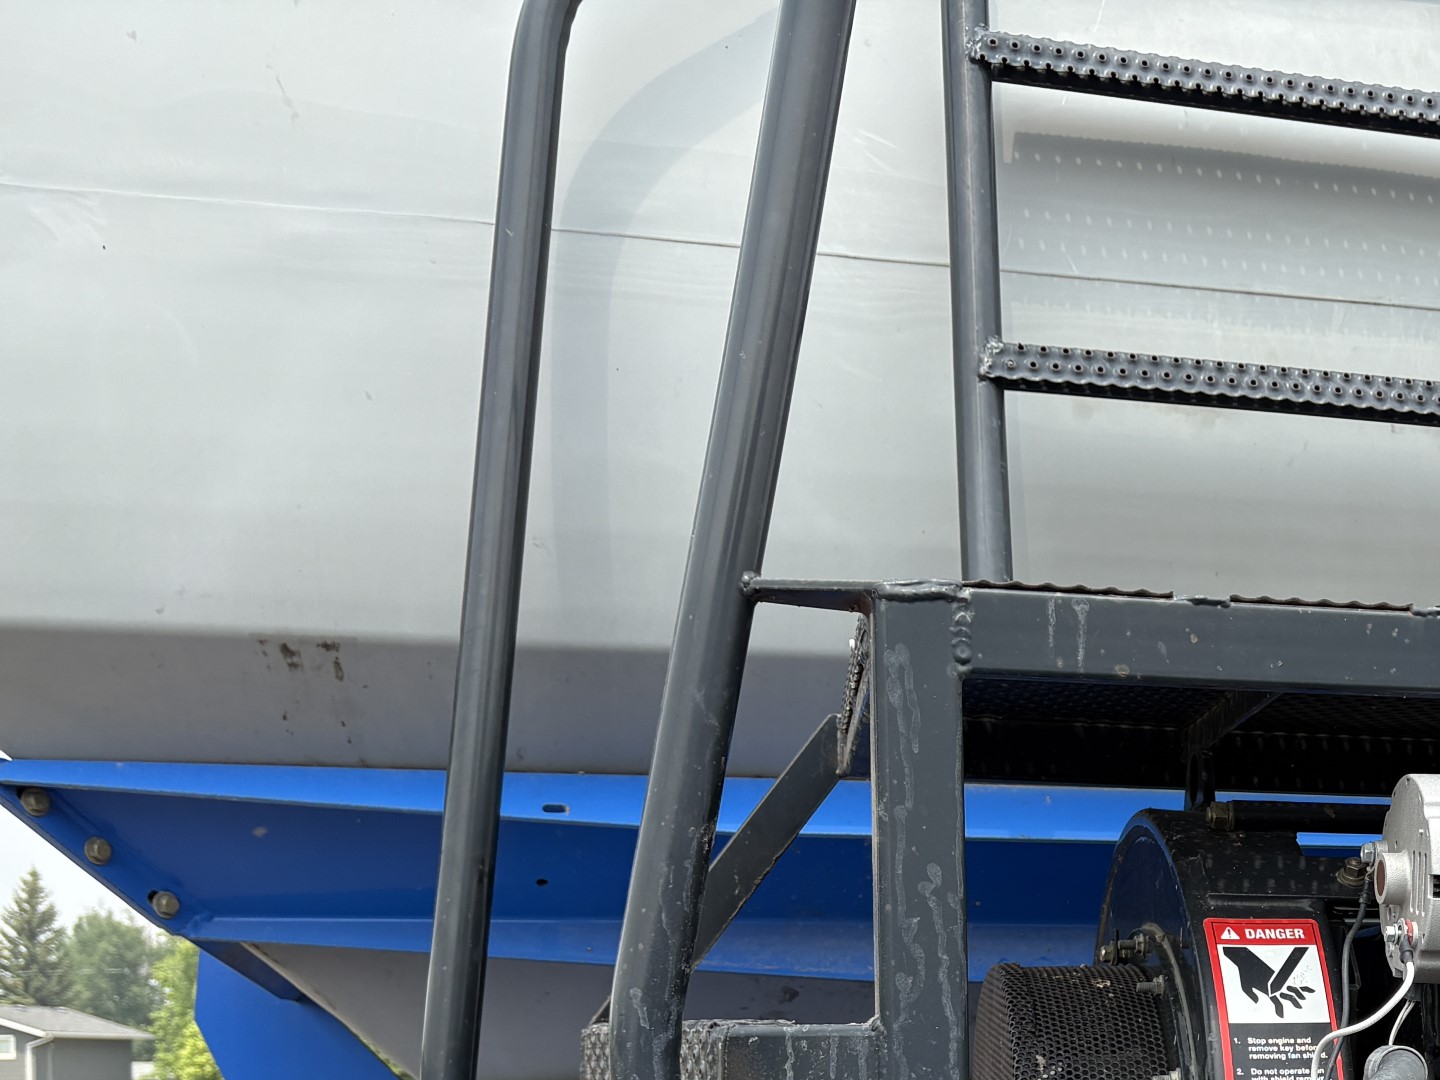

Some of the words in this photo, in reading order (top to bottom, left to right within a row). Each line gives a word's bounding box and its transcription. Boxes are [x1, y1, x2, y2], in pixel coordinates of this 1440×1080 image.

[1245, 928, 1305, 939] DANGER
[1248, 1037, 1266, 1045] Stop
[1268, 1037, 1294, 1046] engine
[1249, 1052, 1286, 1060] removing
[1280, 1068, 1309, 1076] operate
